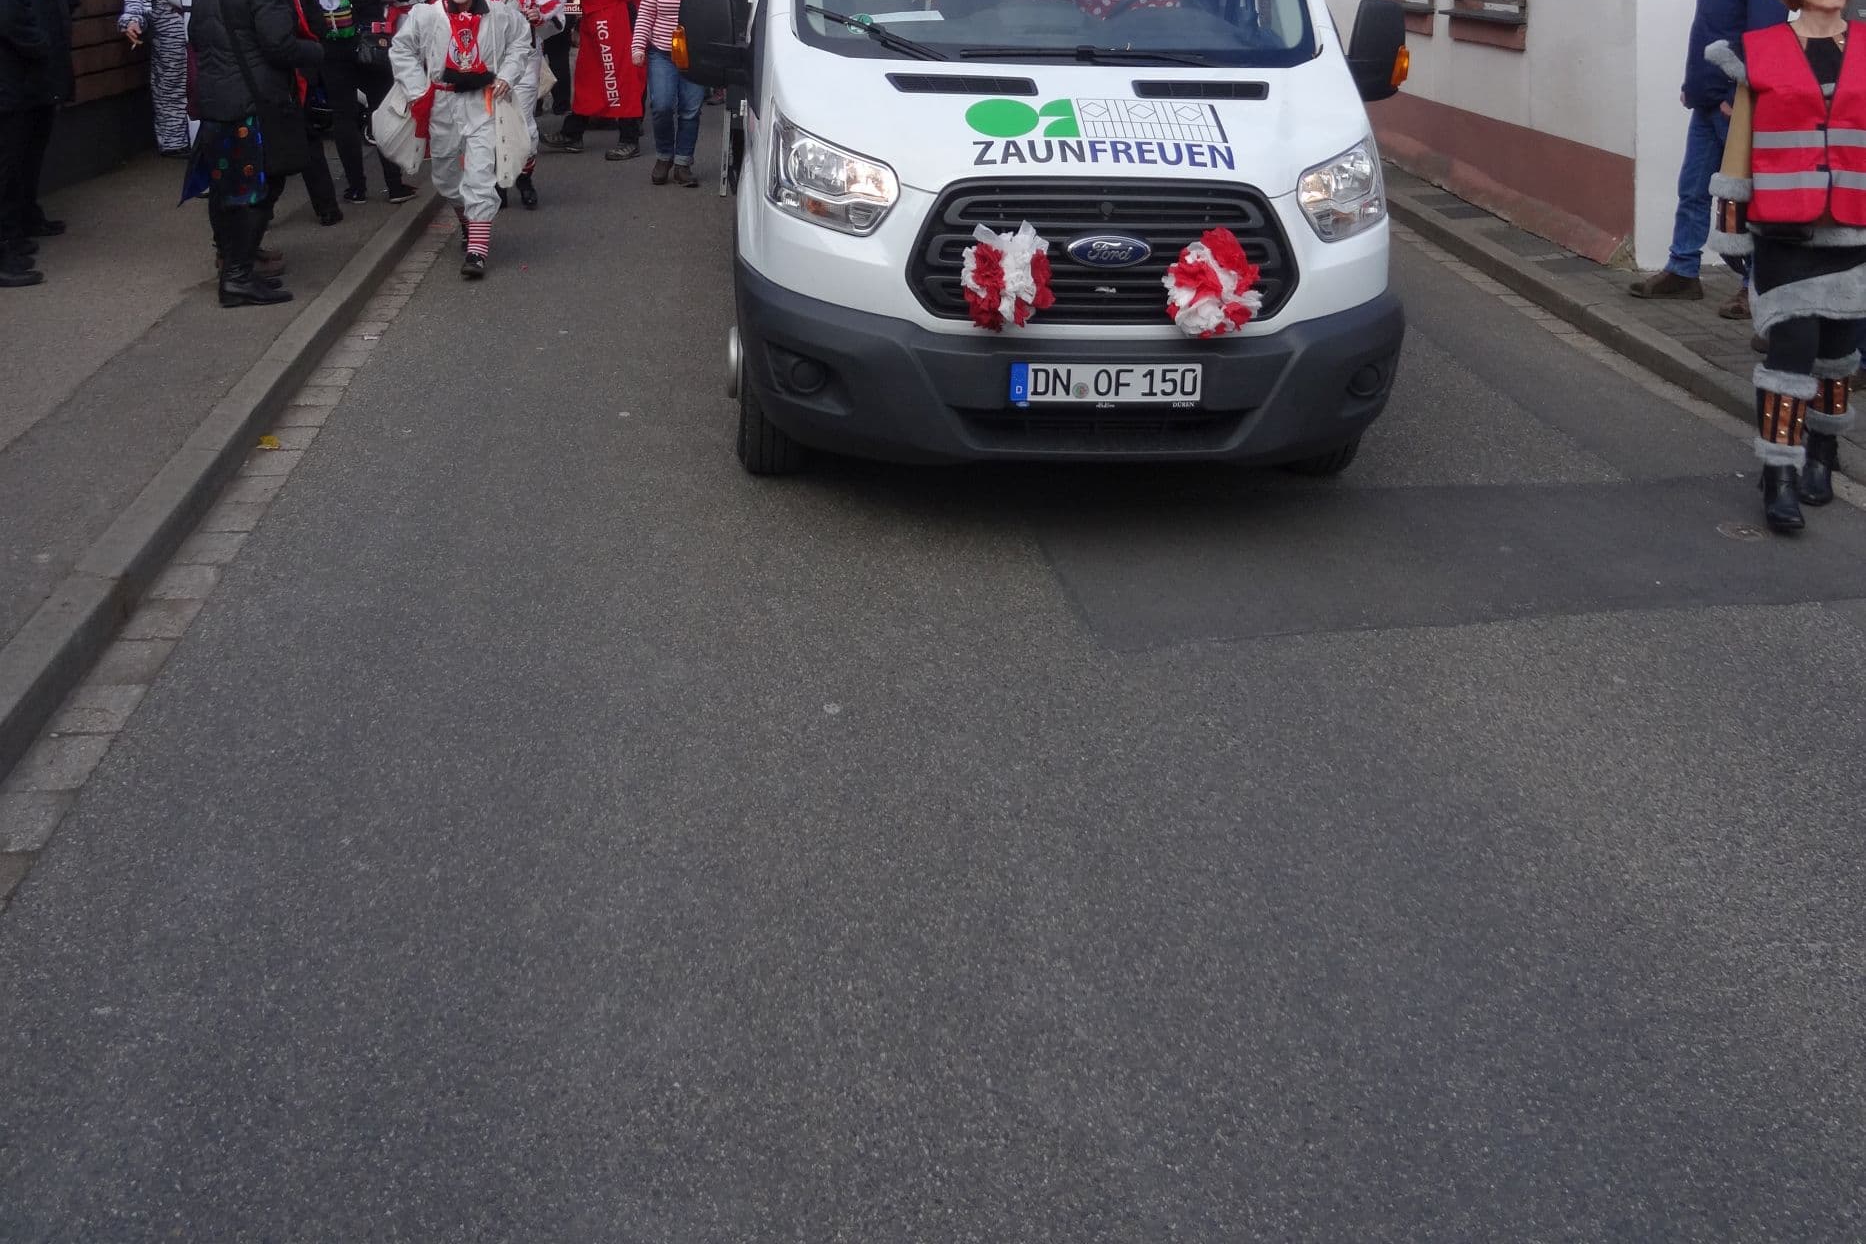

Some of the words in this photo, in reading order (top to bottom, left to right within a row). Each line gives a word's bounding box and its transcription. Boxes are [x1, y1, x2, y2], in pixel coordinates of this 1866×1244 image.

[597, 20, 608, 40] KG
[600, 43, 620, 107] ABENDEN
[973, 140, 1235, 170] ZAUNFREUEN
[1088, 241, 1133, 260] Ford
[1031, 368, 1071, 396] DN
[1094, 368, 1134, 396] OF
[1141, 368, 1197, 396] 150
